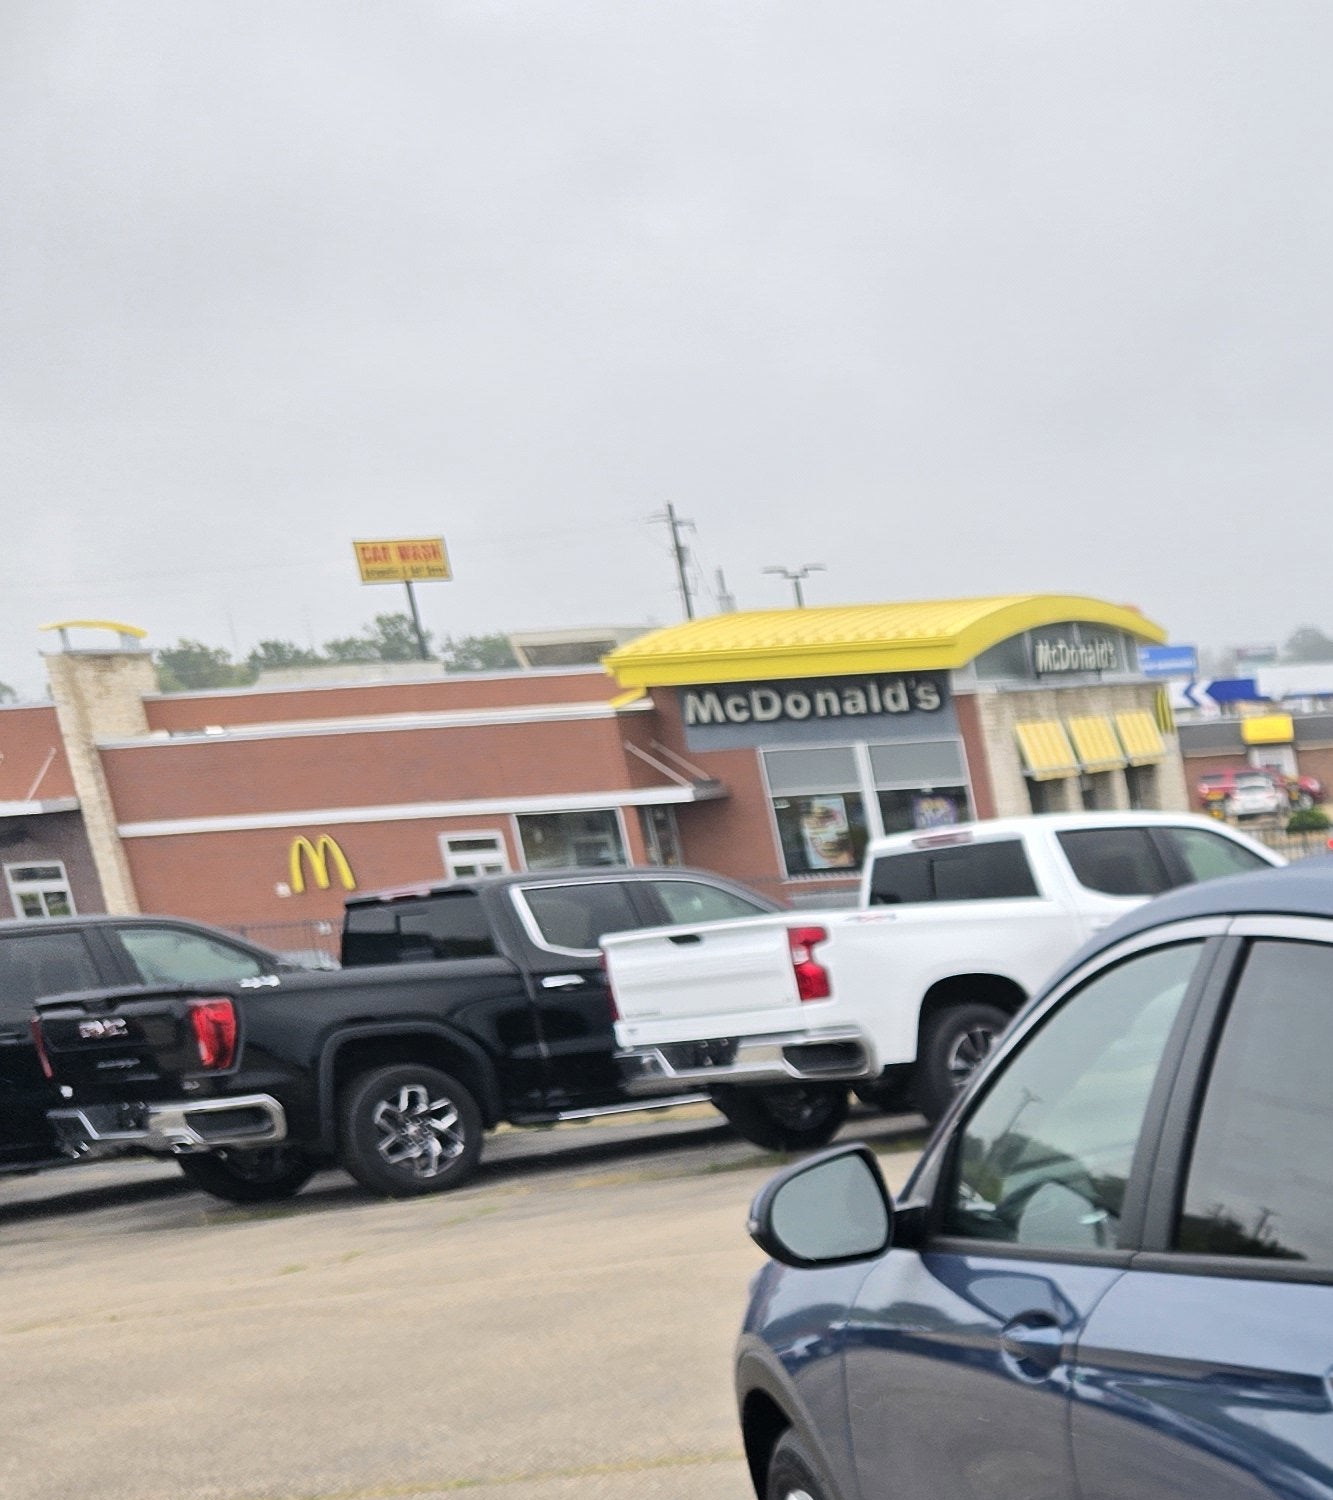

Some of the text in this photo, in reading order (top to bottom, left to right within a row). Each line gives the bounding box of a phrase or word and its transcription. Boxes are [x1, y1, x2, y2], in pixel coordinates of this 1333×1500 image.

[398, 543, 442, 562] WASH
[1035, 637, 1117, 671] McDonald's
[684, 678, 941, 724] McDonald's
